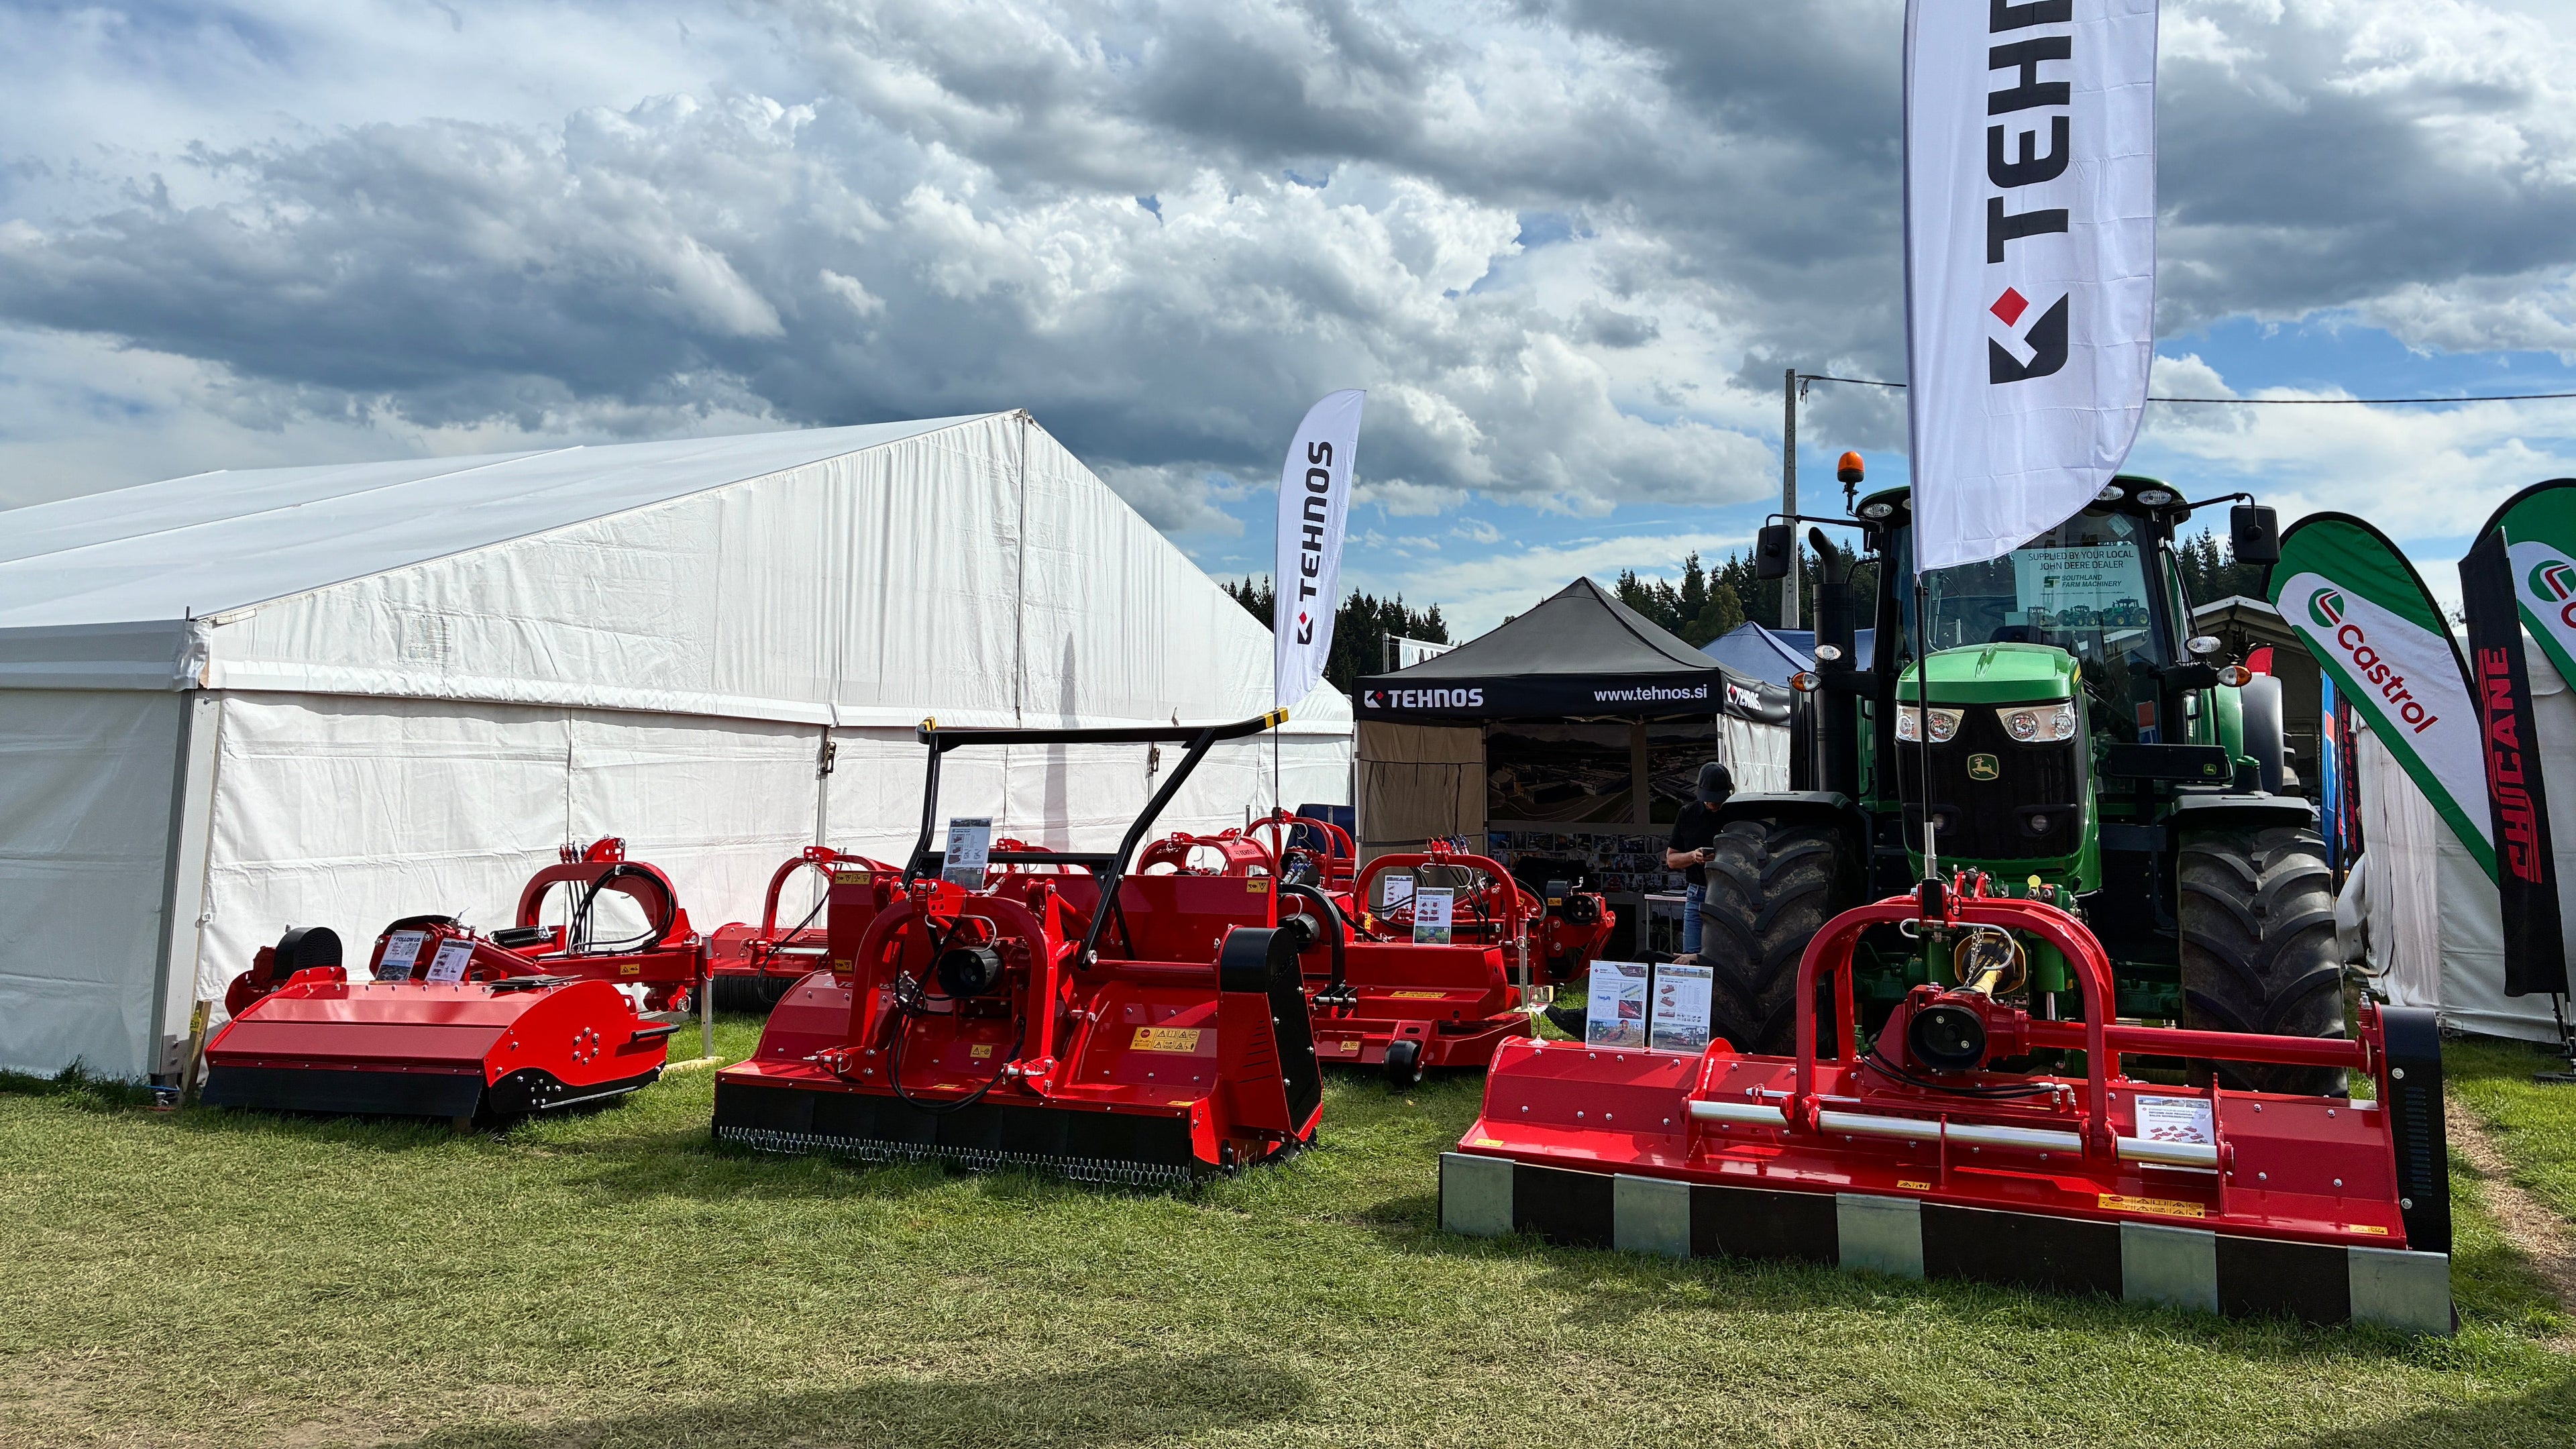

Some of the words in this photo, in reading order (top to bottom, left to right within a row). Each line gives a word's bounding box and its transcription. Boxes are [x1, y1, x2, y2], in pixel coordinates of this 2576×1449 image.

[1299, 441, 1332, 602] TEHNOS
[2029, 552, 2067, 561] SUPPLIED
[2070, 551, 2080, 559] BY
[2081, 551, 2104, 559] YOUR
[2106, 550, 2134, 558] LOCAL
[2039, 561, 2062, 570] JOHN
[2064, 561, 2090, 570] DEERE
[2092, 560, 2124, 569] DEALER
[2338, 625, 2438, 734] Castrol
[1388, 688, 1483, 708] TEHNOS
[1594, 684, 1707, 702] www.tehnos.si
[1733, 685, 1763, 711] TEHNOS
[2479, 647, 2542, 883] CHICANE
